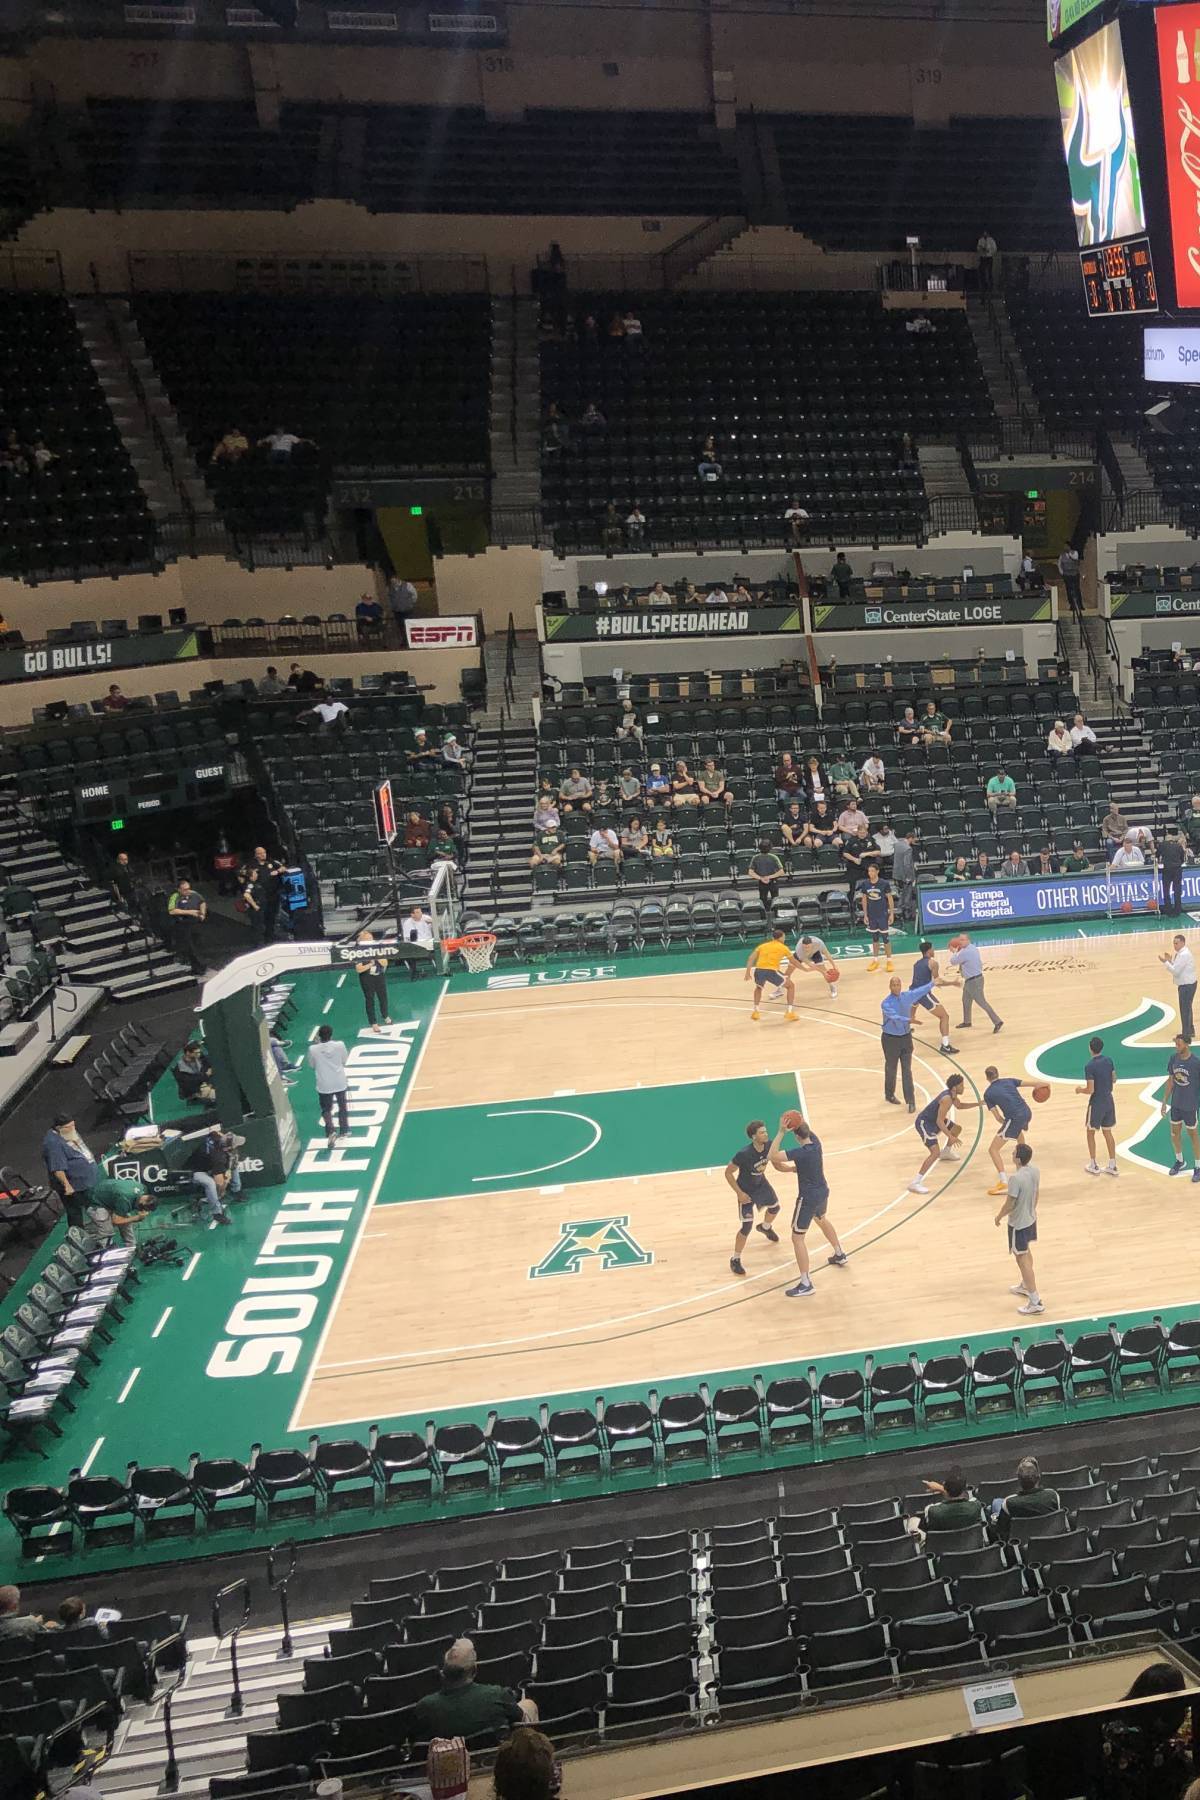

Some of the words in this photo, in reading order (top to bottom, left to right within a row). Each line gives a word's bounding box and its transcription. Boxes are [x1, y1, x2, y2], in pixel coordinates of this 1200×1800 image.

[916, 68, 941, 83] 319
[1069, 471, 1095, 485] 214
[453, 486, 484, 500] 213
[883, 609, 961, 623] CenterState
[964, 606, 1002, 620] LOGE
[595, 611, 749, 635] #BULLSPEEDAHEAD
[410, 626, 473, 643] ESPN
[24, 651, 47, 673] GO
[52, 643, 113, 669] BULLS!
[195, 766, 224, 779] GUEST
[82, 785, 109, 798] HOME
[137, 800, 160, 809] PERIOD
[969, 889, 1004, 901] Tampa
[1036, 886, 1079, 911] OTHER
[1083, 881, 1150, 906] HOSPITALS
[928, 897, 964, 915] TGH
[970, 898, 1010, 910] General
[340, 946, 393, 961] Spectrum
[534, 965, 617, 982] USF
[205, 1189, 359, 1378] SOUTH
